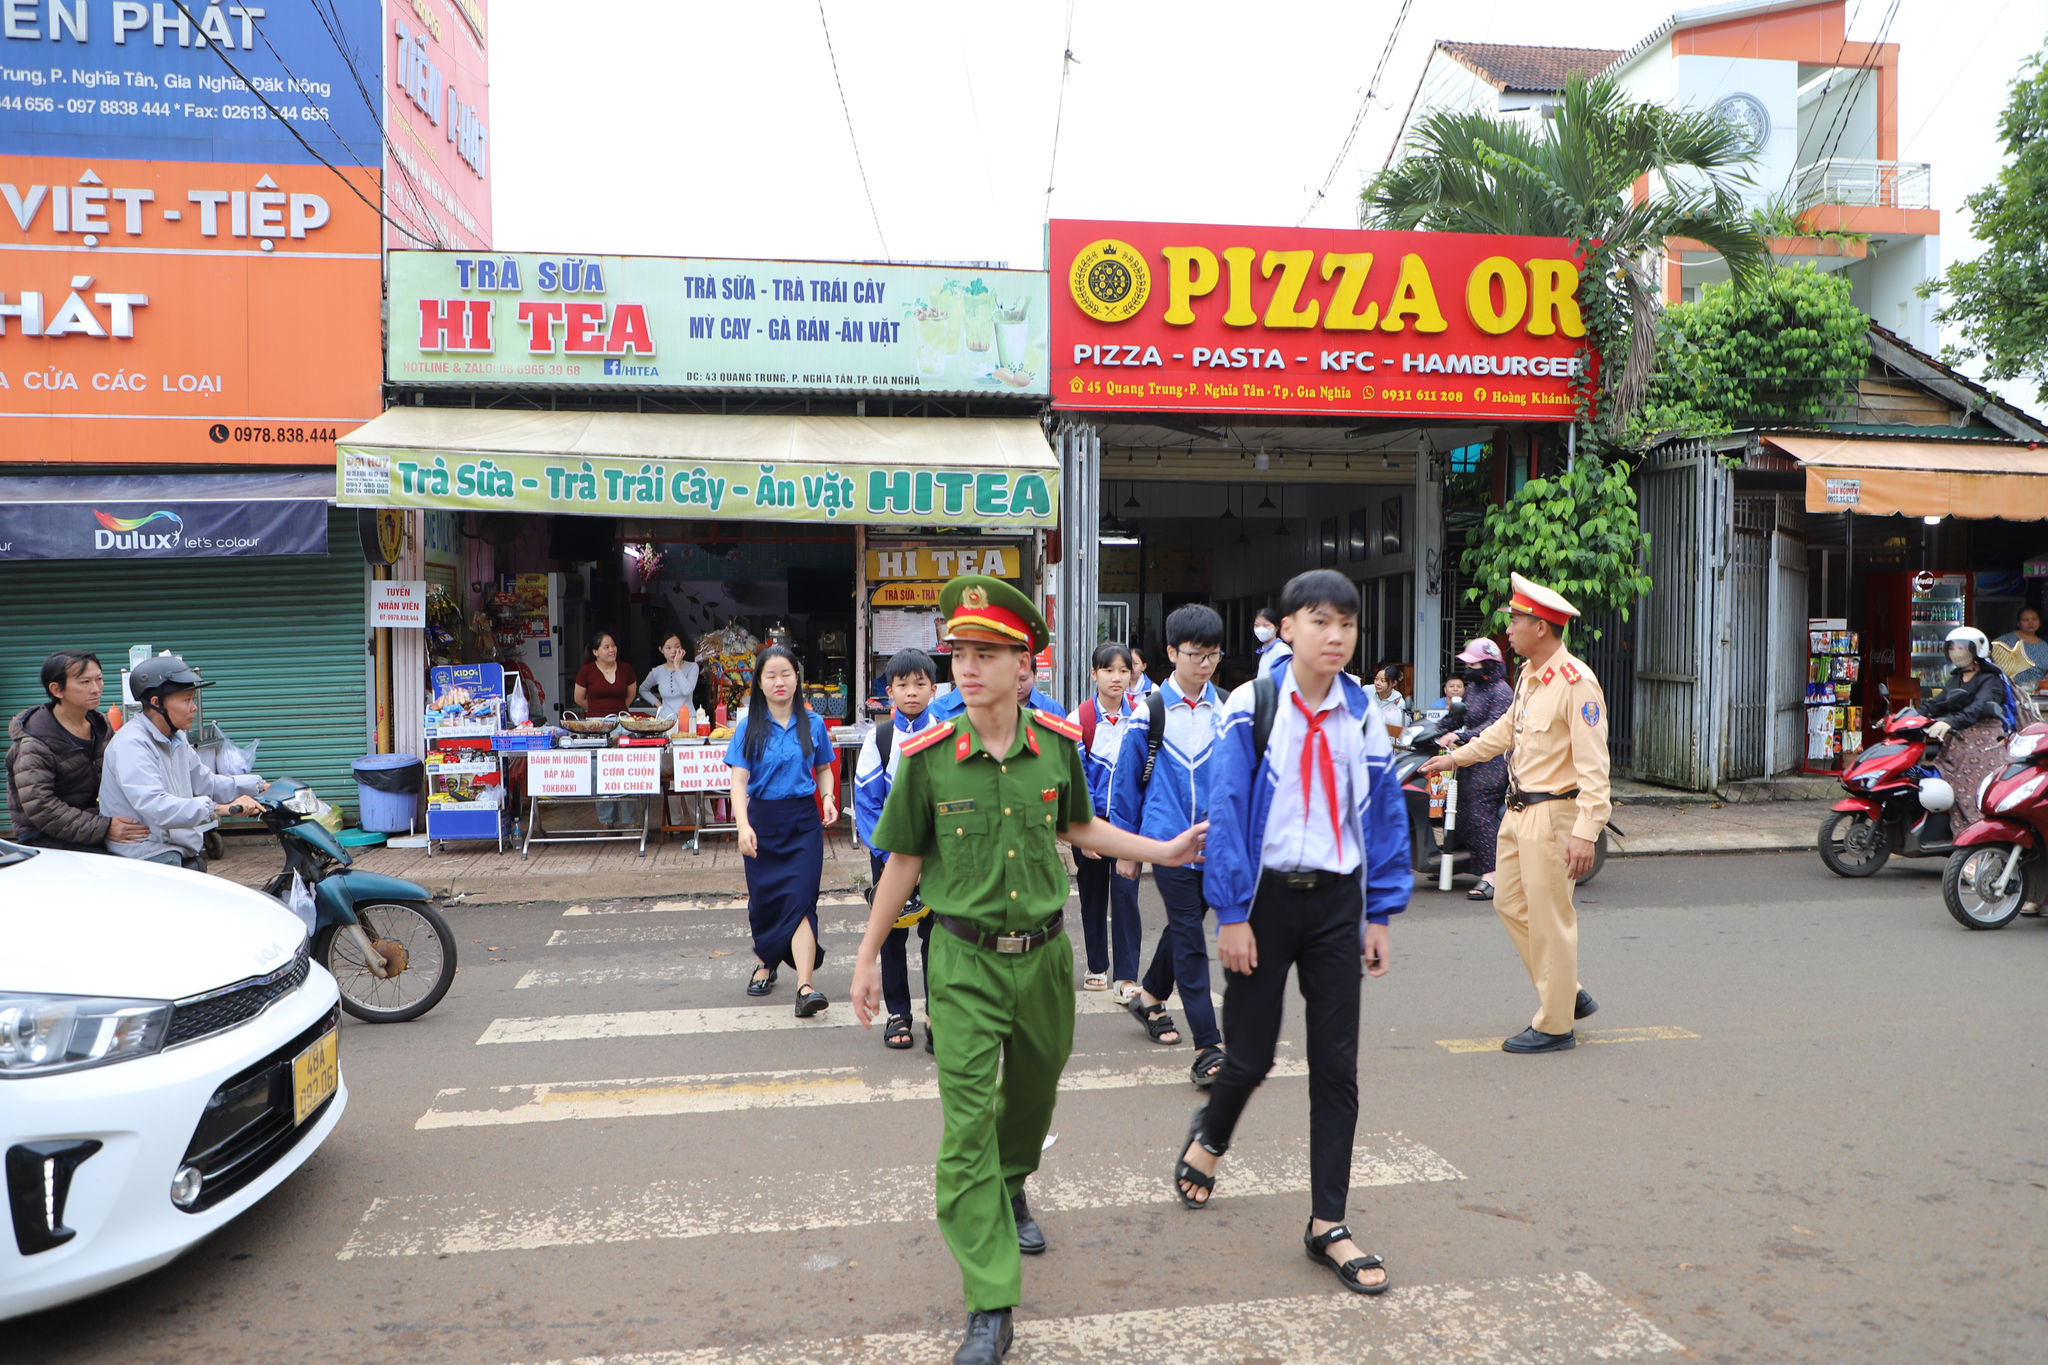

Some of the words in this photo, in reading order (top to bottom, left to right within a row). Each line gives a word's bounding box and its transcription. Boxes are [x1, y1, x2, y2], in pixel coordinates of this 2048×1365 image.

[113, 0, 266, 50] PHÁT
[0, 68, 46, 86] rung,
[51, 69, 67, 84] P.
[72, 70, 120, 88] Nghĩa
[124, 71, 158, 90] Tân,
[164, 74, 191, 89] Gia
[288, 78, 331, 98] Nông
[0, 96, 22, 111] 44
[25, 97, 54, 112] 656
[67, 99, 96, 114] 097
[100, 100, 138, 115] 8838
[142, 102, 170, 117] 444
[184, 104, 218, 119] Fax:
[222, 105, 267, 120] 02613
[0, 168, 155, 247] VIỆT
[188, 173, 331, 252] TIỆP
[456, 256, 522, 291] TRÀ
[538, 257, 606, 293] SỮA
[684, 273, 716, 299] TRÀ
[722, 275, 755, 300] SỮA
[772, 276, 805, 301] TRÀ
[810, 277, 847, 303] TRÁI
[854, 278, 885, 303] CÂY
[1161, 245, 1448, 333] PIZZA
[418, 299, 496, 354] HI
[517, 300, 656, 356] TEA
[690, 313, 714, 339] MỲ
[721, 317, 751, 340] CAY
[769, 315, 790, 341] GÀ
[797, 316, 829, 342] RÁN
[869, 317, 900, 347] VẶT
[403, 362, 449, 374] HOTLINE
[1073, 343, 1163, 367] PIZZA
[1192, 347, 1285, 369] PASTA
[1320, 350, 1375, 373] KFC
[23, 365, 79, 391] CỬA
[91, 369, 147, 392] CÁC
[162, 374, 223, 397] LOẠI
[705, 372, 717, 382] 43
[720, 372, 751, 383] QUANG
[755, 373, 789, 384] TRUNG,
[792, 374, 800, 384] P.
[873, 375, 888, 385] GIA
[1087, 380, 1101, 394] 45
[1106, 381, 1144, 398] Quang
[1204, 383, 1239, 399] Nghĩa
[1243, 383, 1264, 397] Tân
[1297, 385, 1316, 398] Gia
[1320, 385, 1351, 401] Nghĩa
[1382, 388, 1412, 401] 0931
[1416, 389, 1436, 401] 611
[1440, 390, 1464, 402] 208
[1492, 391, 1527, 406] Hoàng
[1531, 392, 1570, 405] Khánh
[234, 427, 337, 443] 0978.838.444
[398, 456, 449, 495] Trà
[456, 459, 515, 498] Sữa
[545, 461, 597, 500] Trà
[603, 464, 665, 503] Trái
[671, 466, 726, 511] Cây
[754, 463, 797, 507] Ăn
[801, 470, 854, 518] Vặt
[867, 469, 1050, 516] HITEA
[95, 529, 171, 550] Dulux
[184, 537, 213, 549] let's
[216, 537, 260, 549] colour
[878, 551, 917, 577] HI
[931, 550, 1006, 577] TEA
[885, 587, 899, 600] TRÀ
[922, 587, 936, 600] TRÀ
[378, 600, 400, 610] NHÂN
[402, 600, 419, 611] VIÊN
[602, 753, 624, 762] CƠM
[679, 750, 694, 760] MÌ
[603, 766, 625, 776] CƠM
[628, 766, 655, 778] CUỘN
[683, 765, 698, 774] MÌ
[542, 784, 577, 793] TOKBOKKI
[681, 780, 701, 788] NUI
